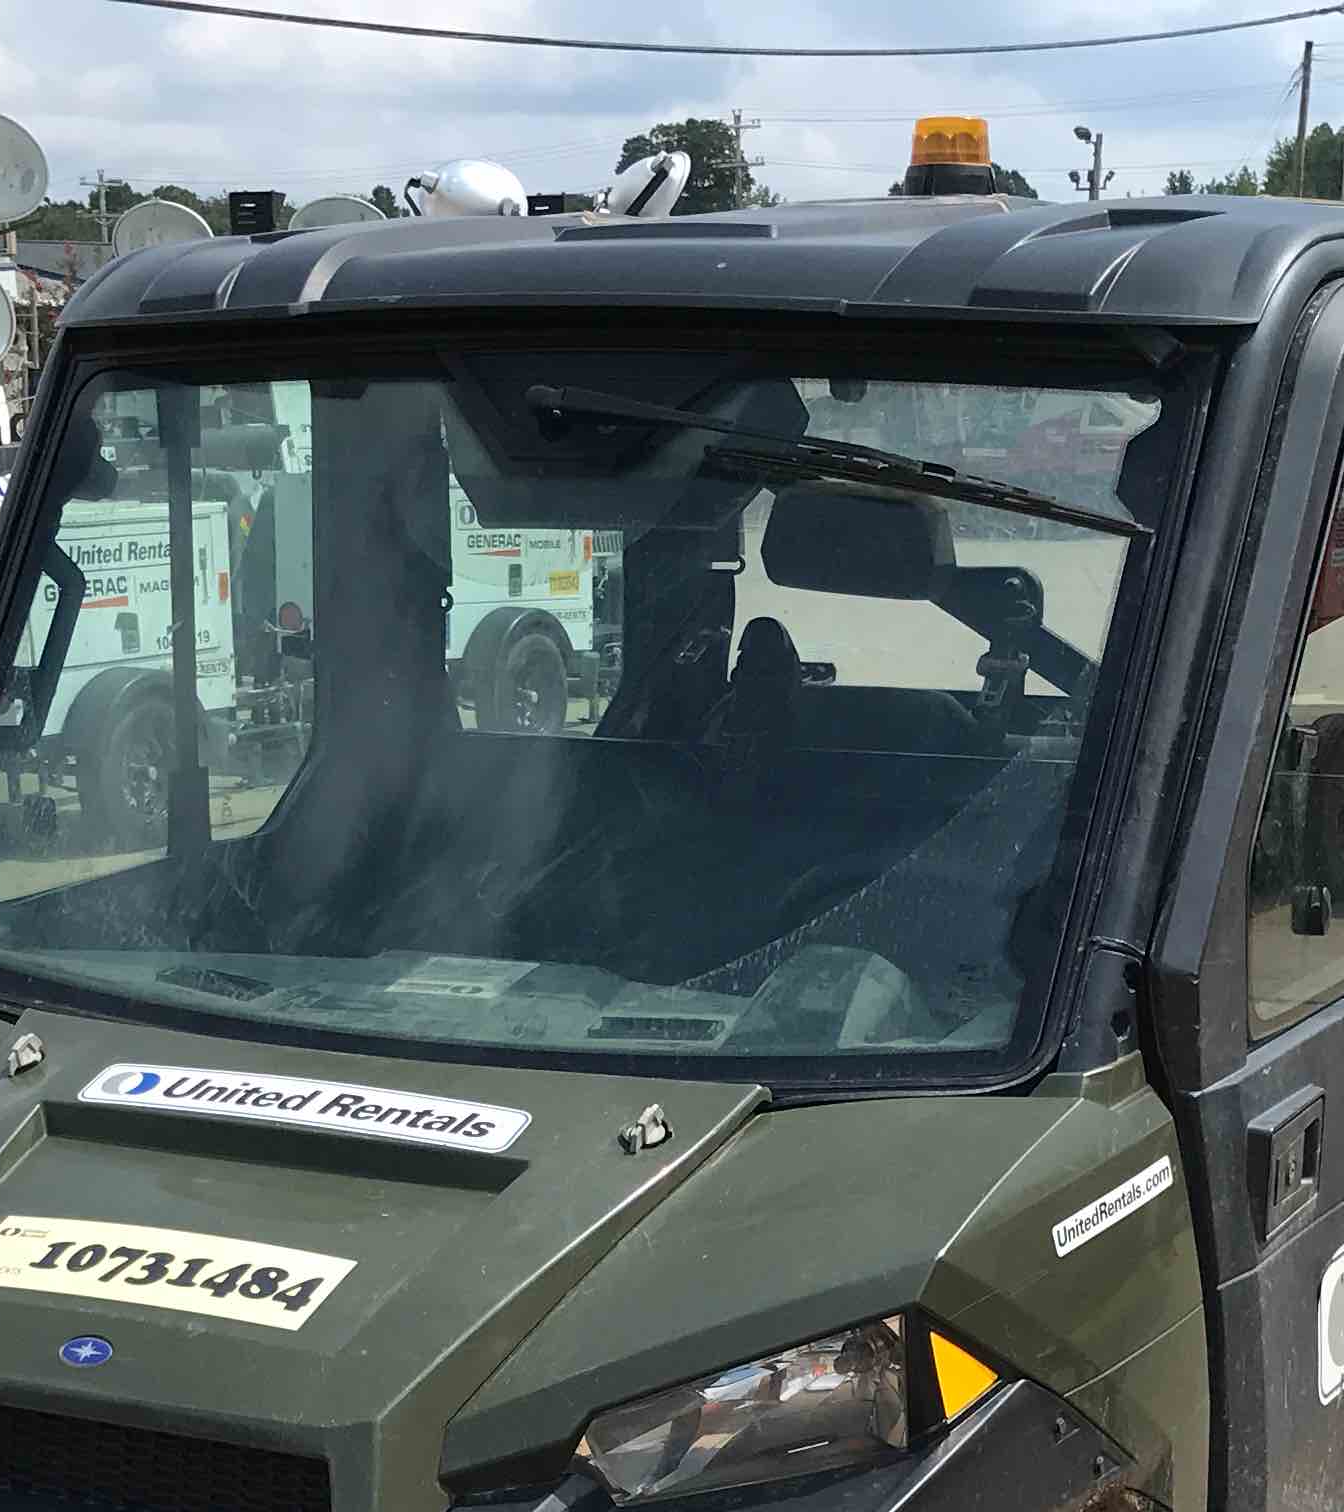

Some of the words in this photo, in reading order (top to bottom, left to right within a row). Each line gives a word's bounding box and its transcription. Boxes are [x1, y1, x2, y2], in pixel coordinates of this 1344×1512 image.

[69, 543, 123, 566] United
[128, 541, 172, 561] Renta
[467, 534, 522, 549] GENERAC
[44, 575, 128, 602] GERAC
[162, 1075, 321, 1113] United
[317, 1091, 497, 1139] Rentals
[1056, 1166, 1170, 1248] UnitedRentals.com
[29, 1241, 325, 1312] 10731484
